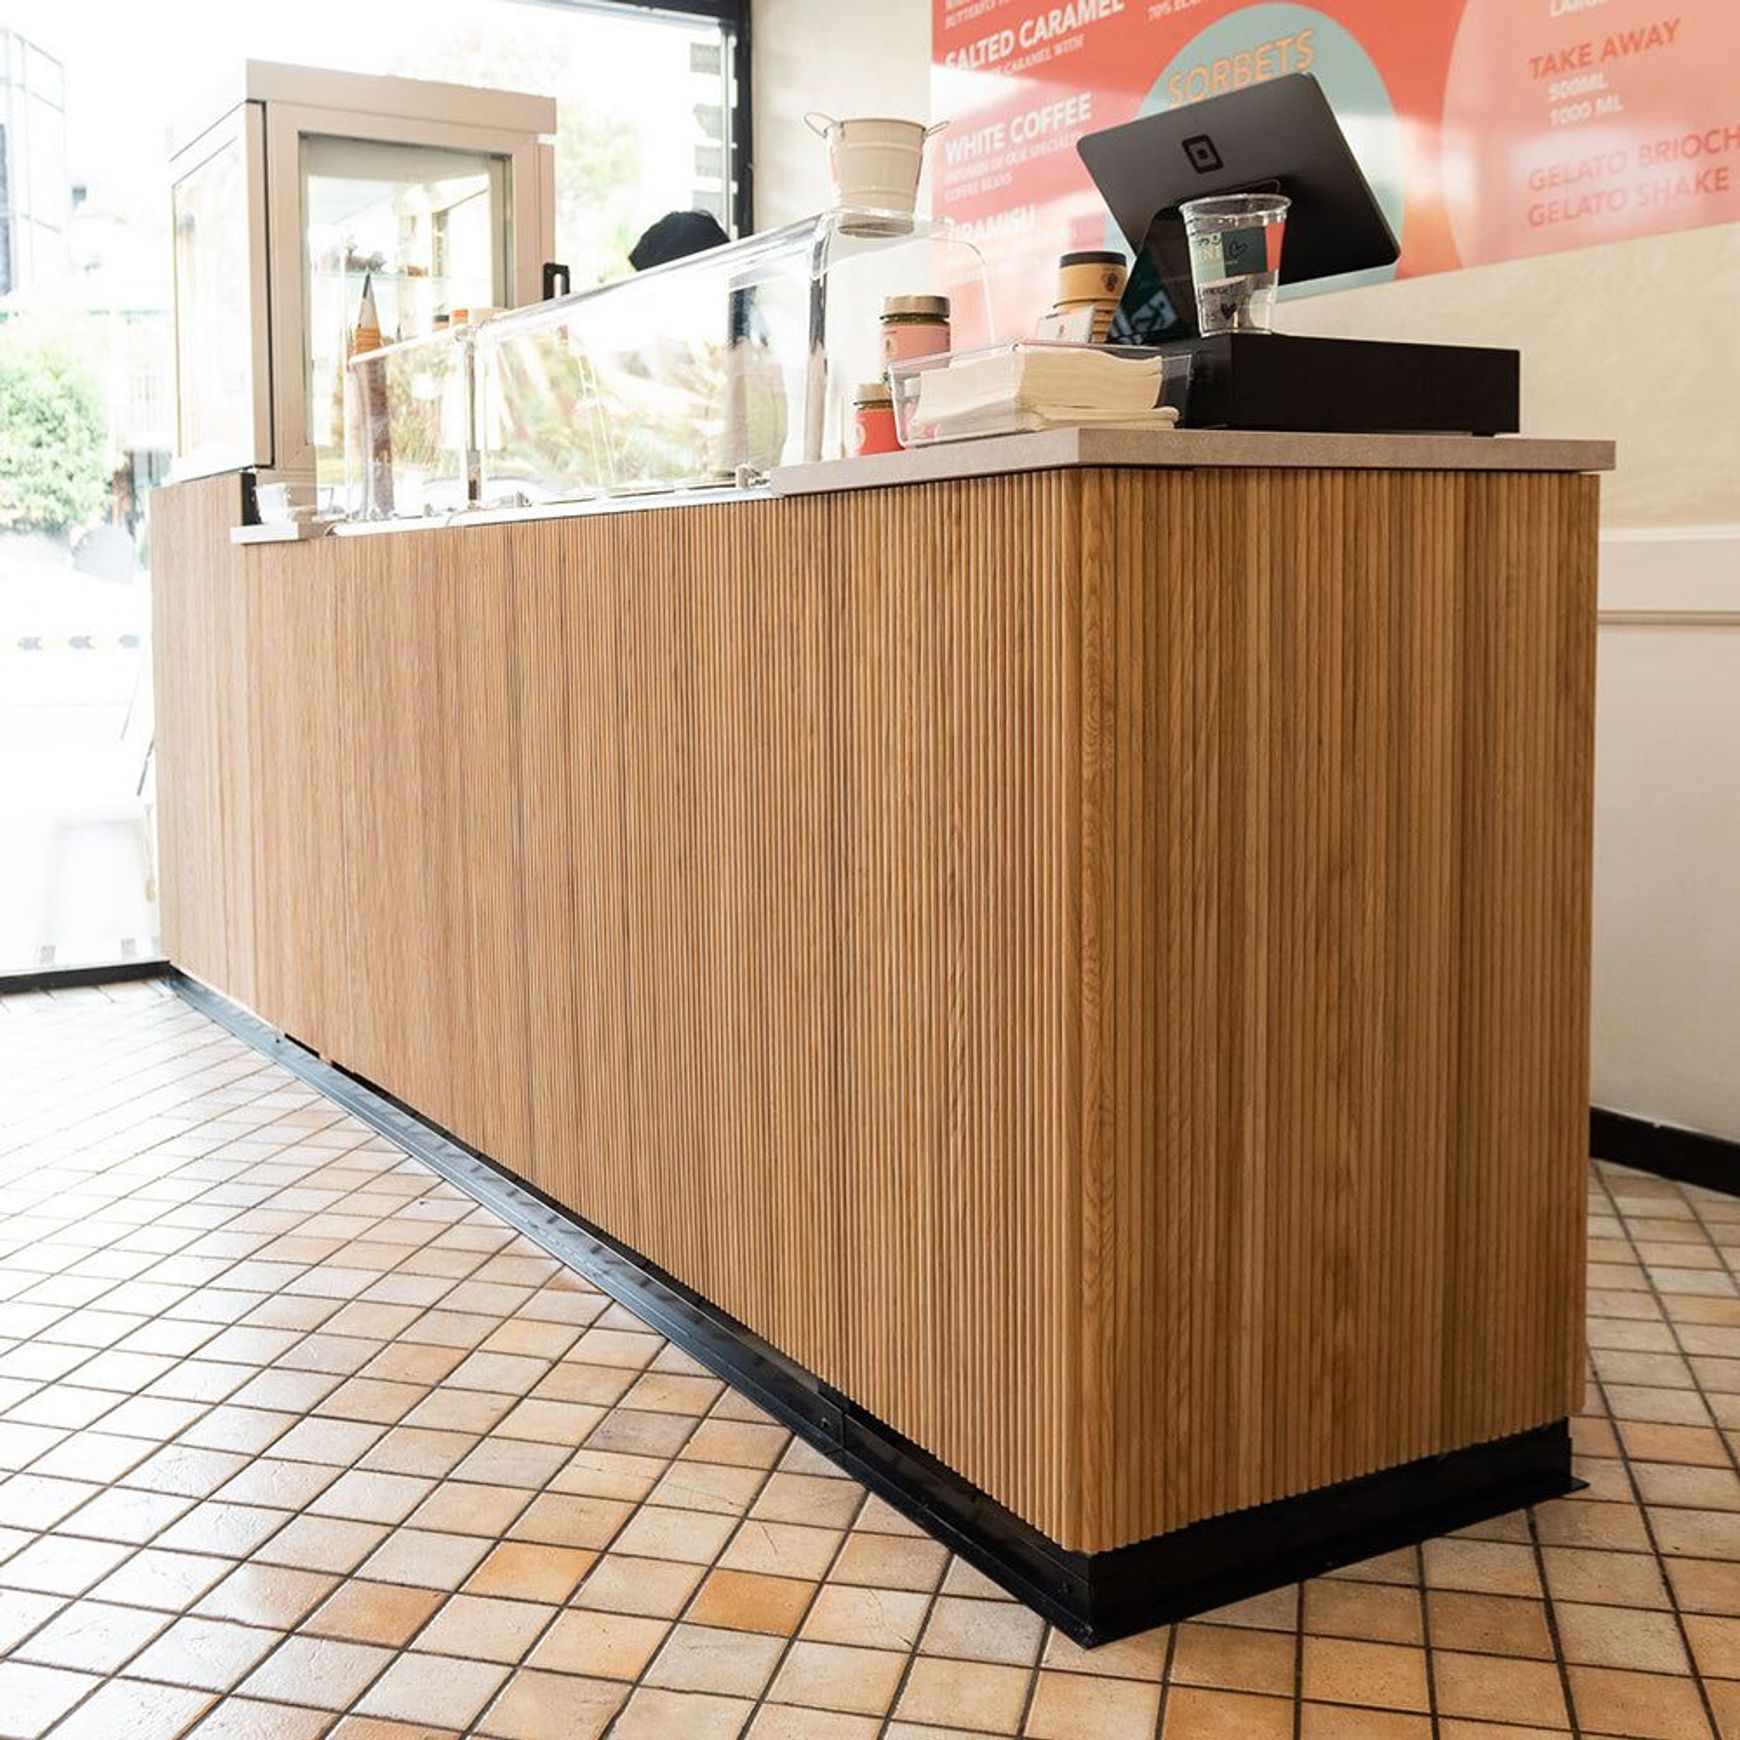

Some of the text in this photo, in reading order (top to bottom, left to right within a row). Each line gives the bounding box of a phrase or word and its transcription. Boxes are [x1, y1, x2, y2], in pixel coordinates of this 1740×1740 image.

[945, 29, 1014, 70] SALTED
[1167, 28, 1316, 109] SORBETS
[1529, 17, 1681, 80] TAKE AWAY
[945, 122, 1006, 164] WHITE
[1009, 91, 1093, 143] COFFEE
[1550, 94, 1625, 128] 1000 ML
[1528, 150, 1628, 192] GELATO
[1528, 167, 1730, 227] GELATO SHAKE
